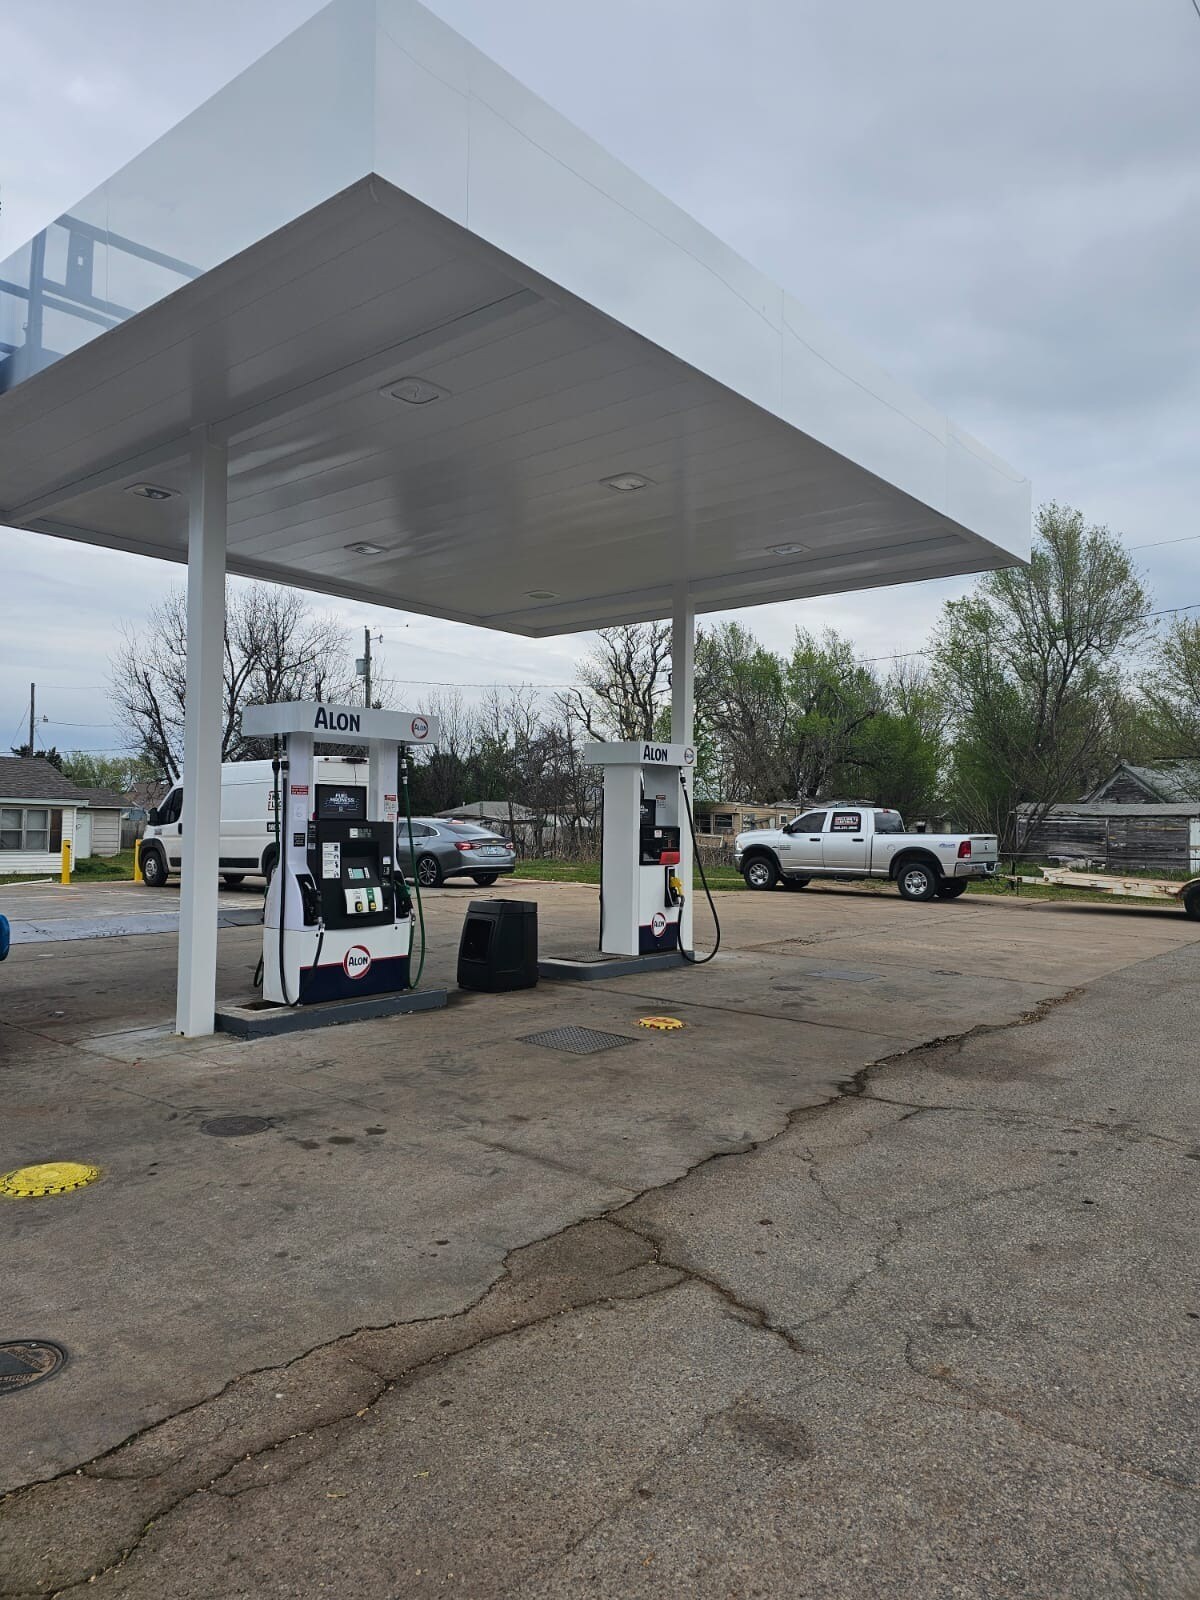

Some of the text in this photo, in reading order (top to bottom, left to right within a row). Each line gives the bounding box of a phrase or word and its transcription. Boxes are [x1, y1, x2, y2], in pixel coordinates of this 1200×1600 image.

[314, 706, 360, 733] ALON
[643, 744, 668, 762] ALON
[348, 956, 369, 967] ALON
